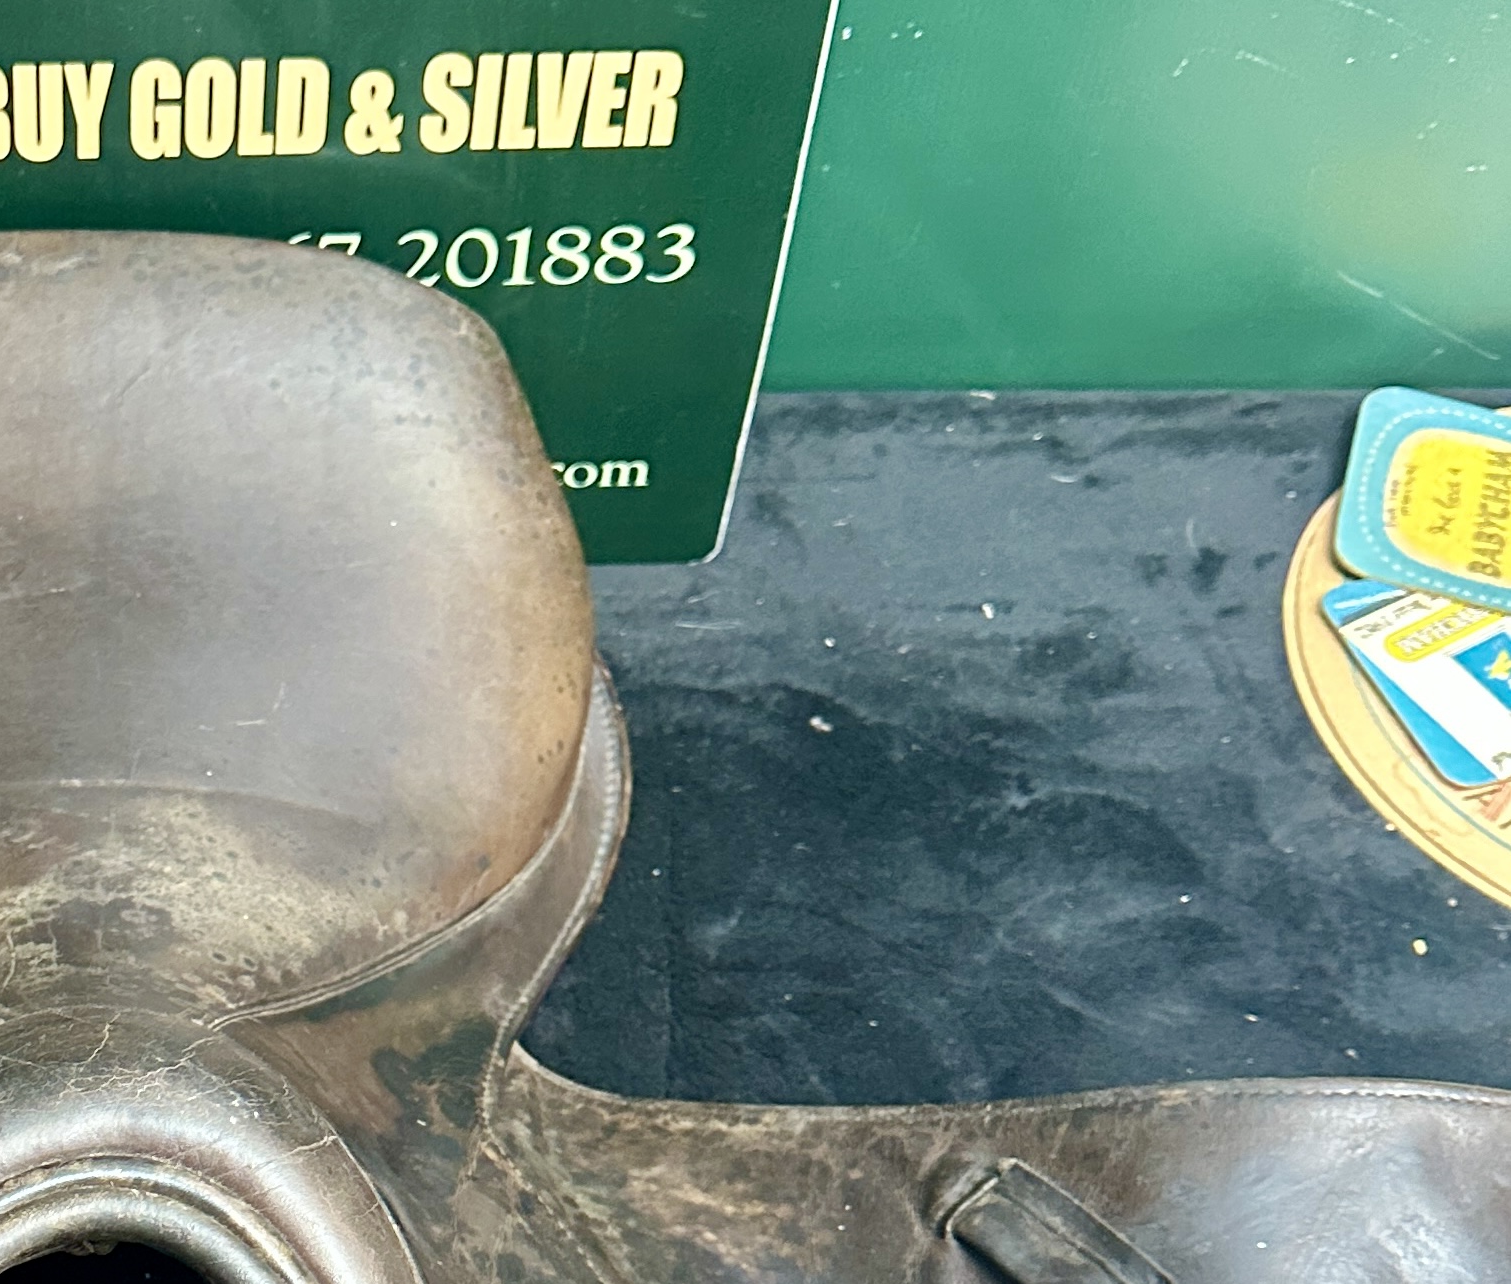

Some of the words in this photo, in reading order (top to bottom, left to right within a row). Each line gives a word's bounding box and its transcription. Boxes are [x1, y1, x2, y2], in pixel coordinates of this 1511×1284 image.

[129, 56, 330, 160] GOLD
[344, 69, 404, 155] &
[419, 50, 684, 153] SILVER
[398, 223, 696, 288] 201883
